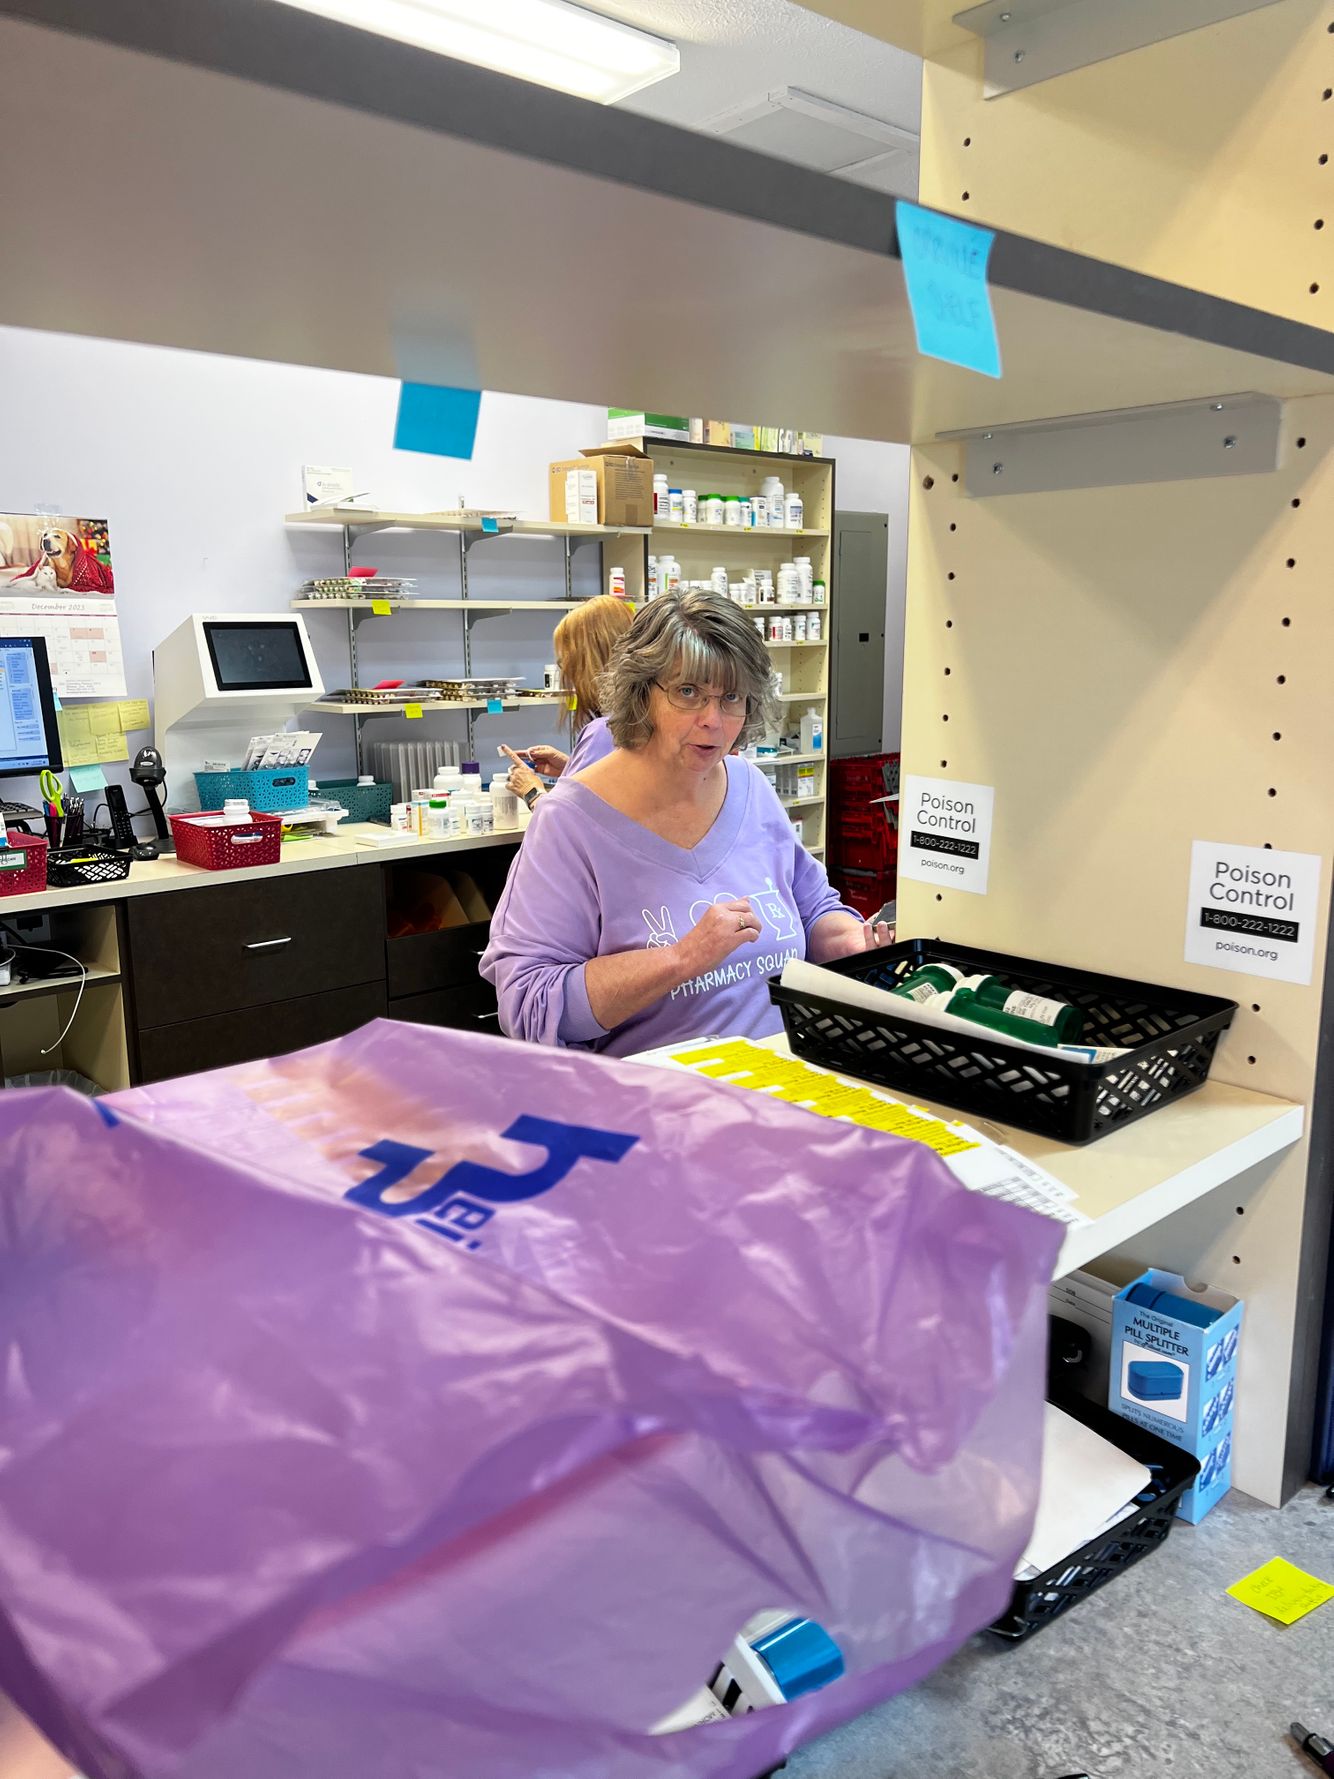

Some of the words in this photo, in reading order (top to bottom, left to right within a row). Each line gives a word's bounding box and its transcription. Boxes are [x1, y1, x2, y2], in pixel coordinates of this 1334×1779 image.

[920, 792, 975, 815] Poison
[917, 809, 976, 833] Control
[913, 834, 977, 855] 1-800-222-1222
[920, 859, 965, 875] poison.org
[1215, 861, 1291, 889] Poison
[1209, 882, 1294, 911] Control
[1204, 912, 1296, 937] 1-800-222-1222
[1215, 941, 1279, 961] poison.org
[1133, 1316, 1180, 1341] MULTIPLE
[1140, 1311, 1150, 1319] The
[1151, 1315, 1174, 1327] Original
[1125, 1325, 1143, 1340] PILL
[1145, 1333, 1189, 1356] SPLITTER
